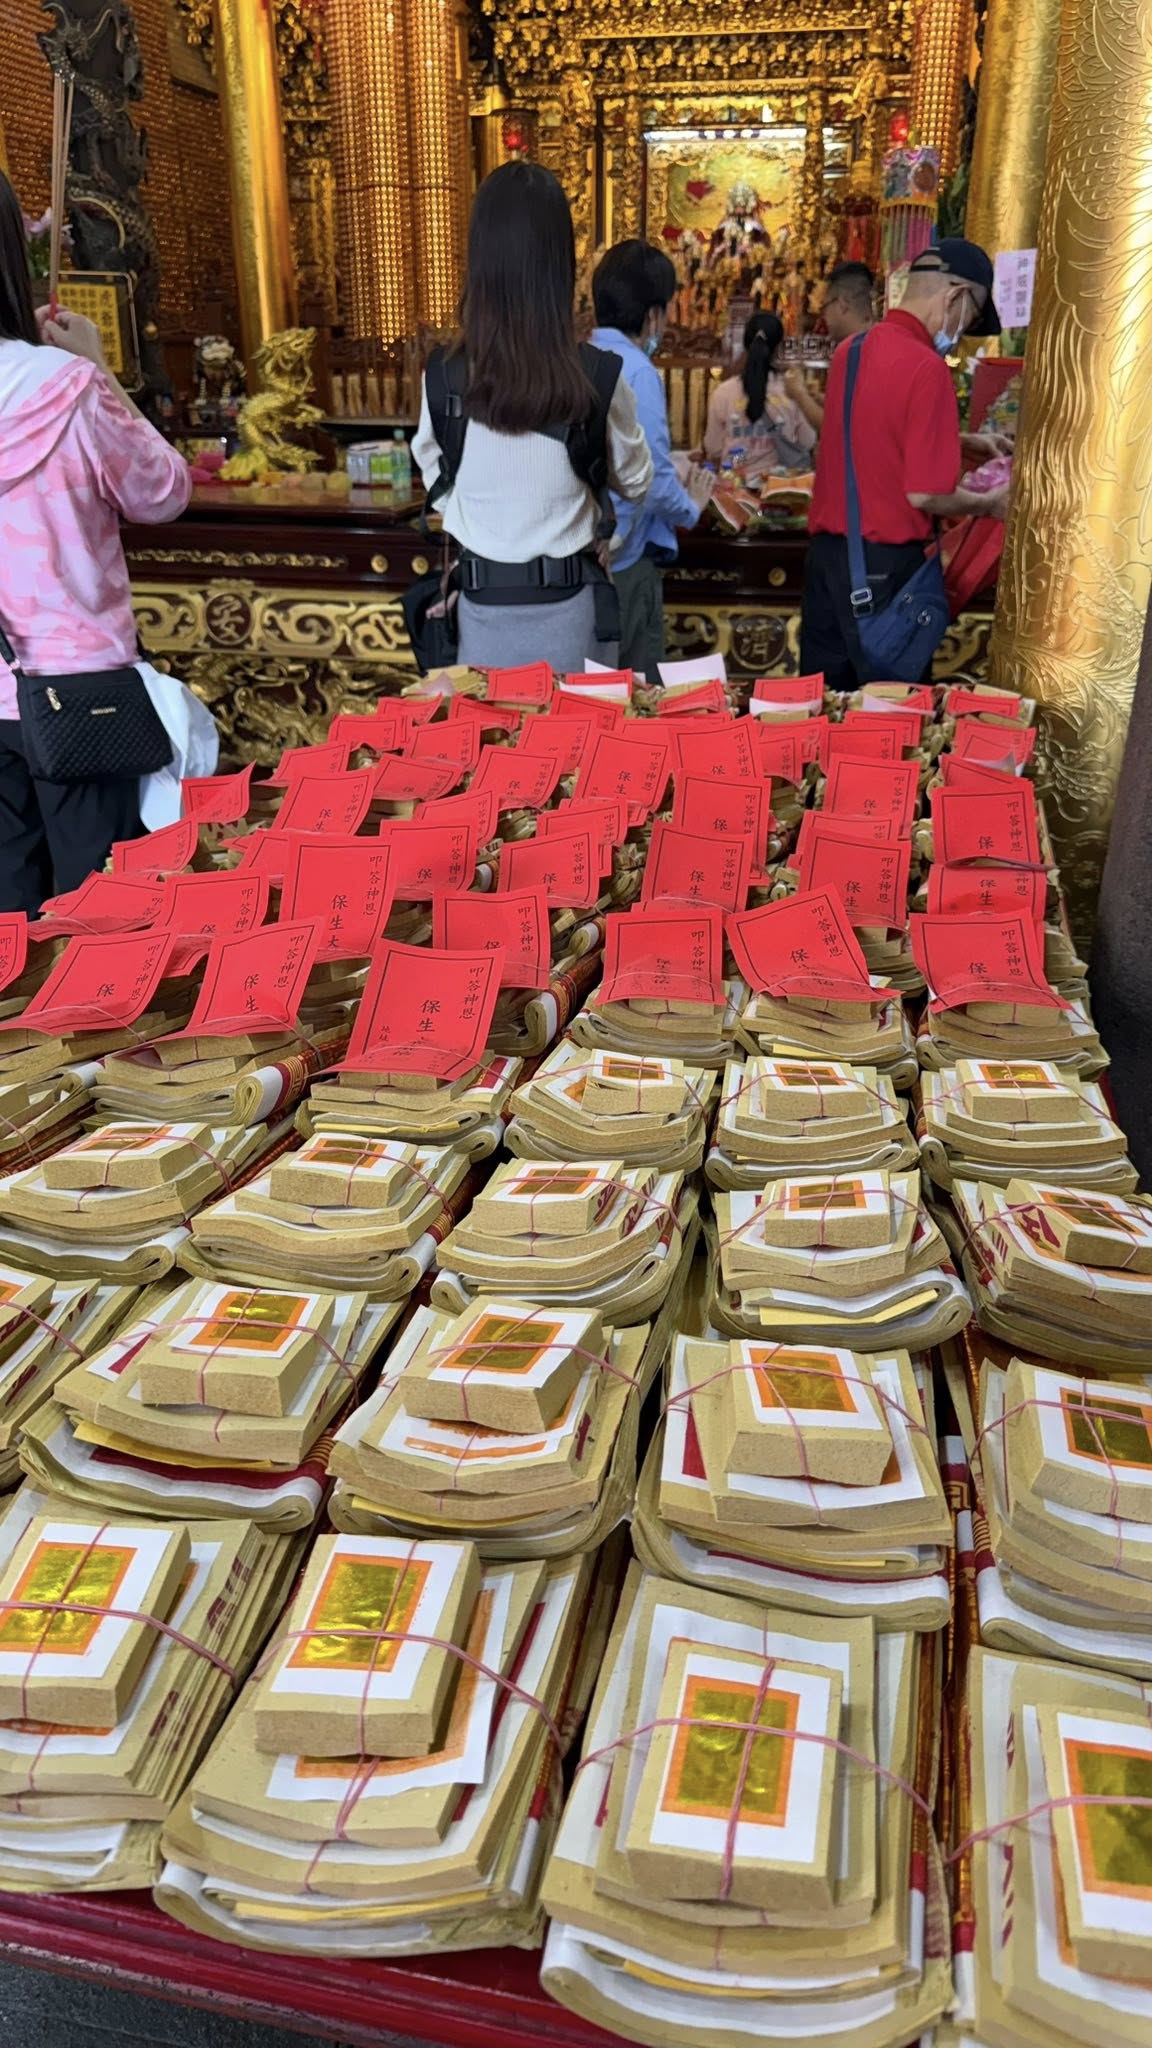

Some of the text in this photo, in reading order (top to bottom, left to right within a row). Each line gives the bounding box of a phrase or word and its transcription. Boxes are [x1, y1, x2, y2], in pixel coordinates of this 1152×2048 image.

[362, 855, 383, 916] 叩答神恩
[720, 848, 737, 891] 叩答神恩
[877, 857, 894, 904] 叩答神恩
[811, 905, 843, 958] 叩答神恩
[1002, 928, 1024, 977] 叩答神恩
[128, 943, 161, 1002] 叩答神恩
[274, 935, 305, 988] 叩答神恩
[96, 983, 115, 998] 保
[243, 973, 260, 1015] 保生
[458, 966, 485, 1020] 叩答神恩
